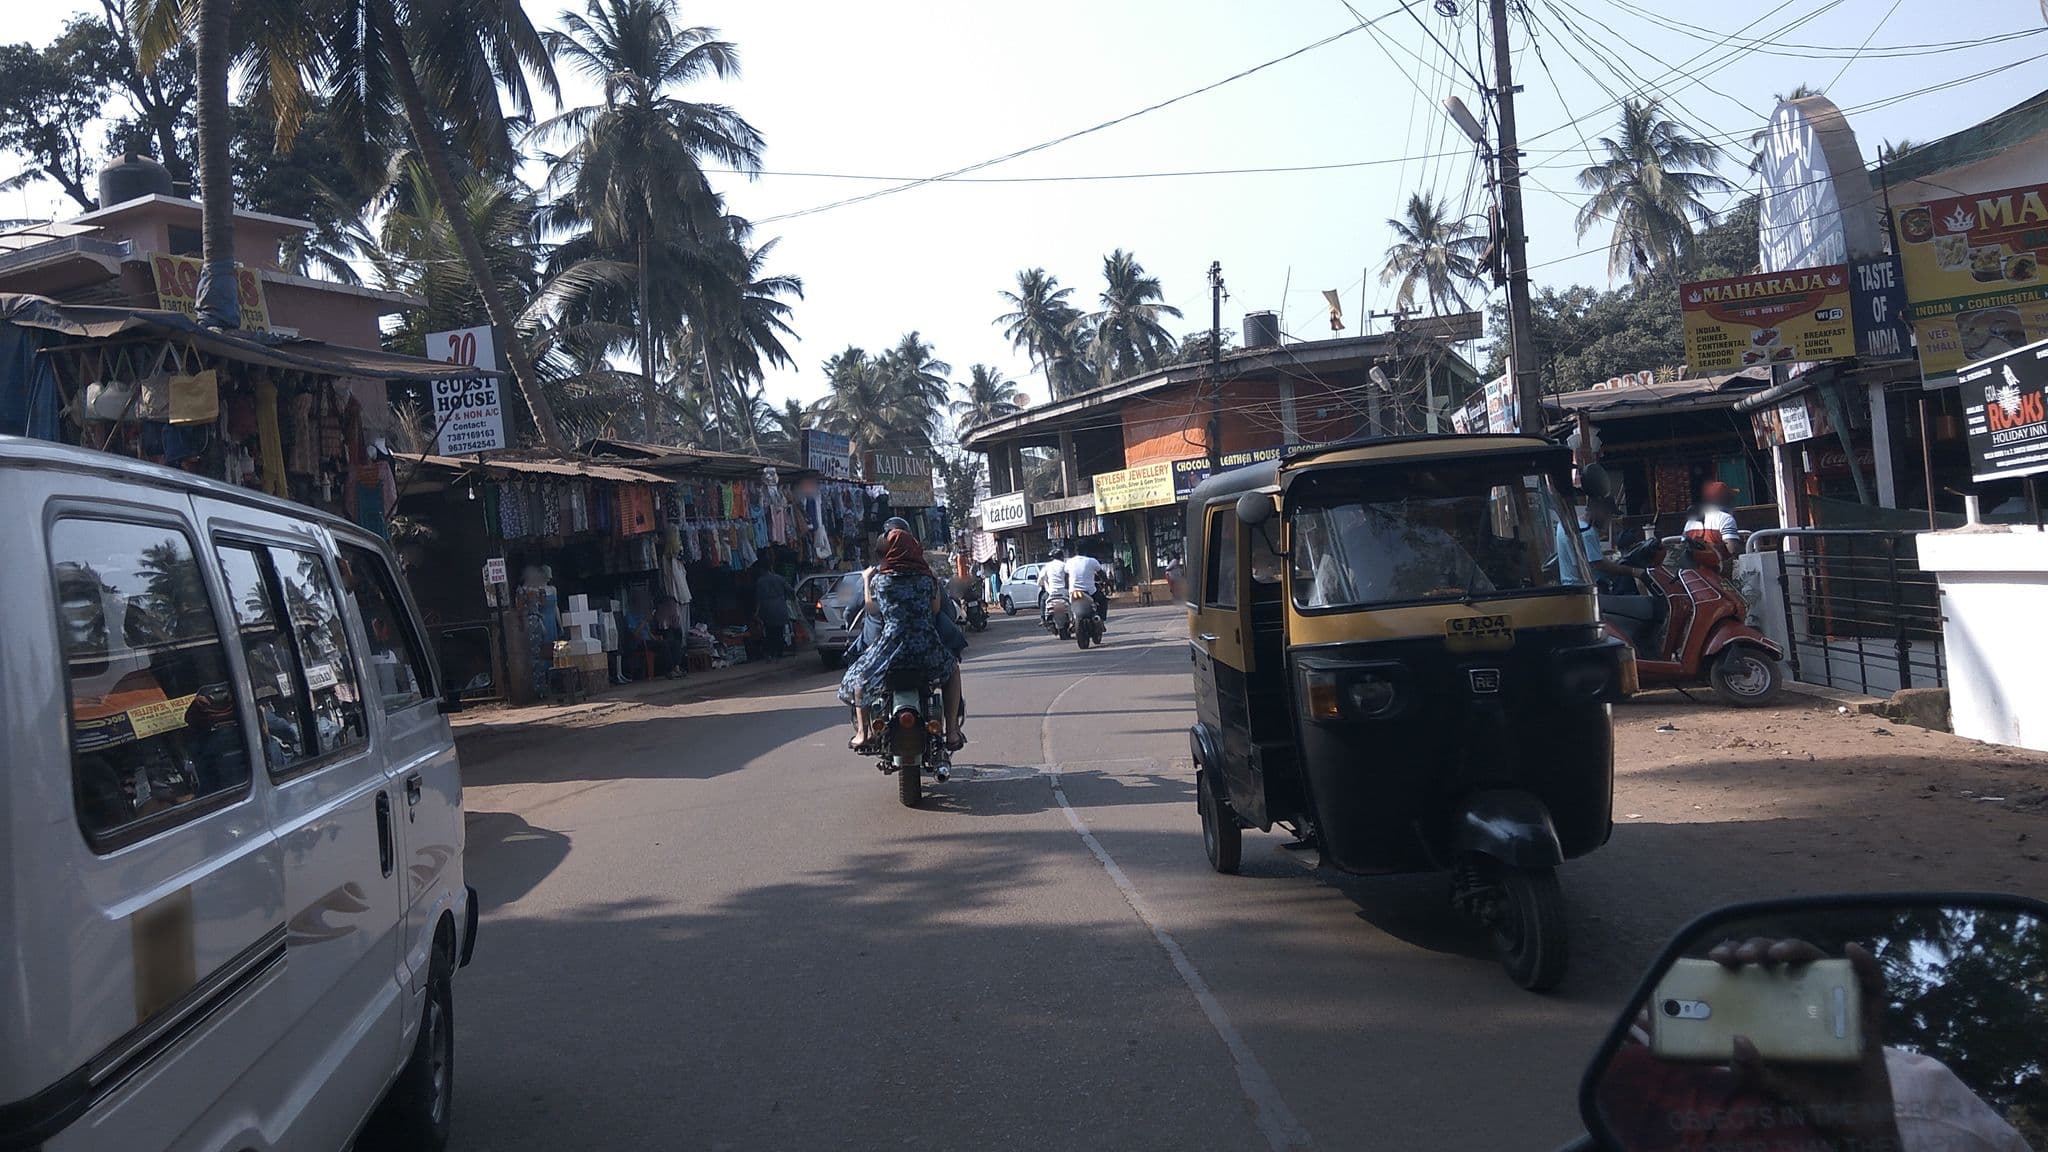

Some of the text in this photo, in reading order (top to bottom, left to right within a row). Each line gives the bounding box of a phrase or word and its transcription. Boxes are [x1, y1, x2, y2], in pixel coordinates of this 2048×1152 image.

[155, 256, 259, 307] ROS
[1858, 261, 1895, 291] TASTE
[1702, 274, 1826, 303] MAHARAJA
[1872, 296, 1888, 323] OF
[1915, 291, 2041, 317] INDIAN CONTINENTAL
[1696, 326, 1721, 335] INDIAN
[1696, 333, 1729, 343] CHINEES
[1804, 328, 1846, 339] BREAKFAST
[1927, 329, 1949, 341] VEG
[1697, 340, 1746, 351] CONTINENTAL
[1805, 339, 1830, 348] LUNCH
[1868, 328, 1900, 356] INDIA
[1697, 349, 1735, 359] TANDOORI
[1805, 347, 1833, 356] DINNER
[1698, 358, 1732, 368] SEAFOOD
[436, 377, 492, 395] GUEST
[437, 391, 497, 412] HOUSE
[455, 413, 461, 421] &
[463, 411, 483, 420] NON
[452, 421, 487, 431] Contact:
[1993, 429, 2029, 444] HOLIDAY
[2029, 424, 2047, 437] INN
[876, 455, 930, 479] KAJU KING
[1176, 459, 1210, 473] CHOCOLA
[1254, 449, 1281, 462] HOUSE
[1096, 464, 1169, 486] STYLESH JEWELLERY
[990, 504, 1024, 523] tattoo
